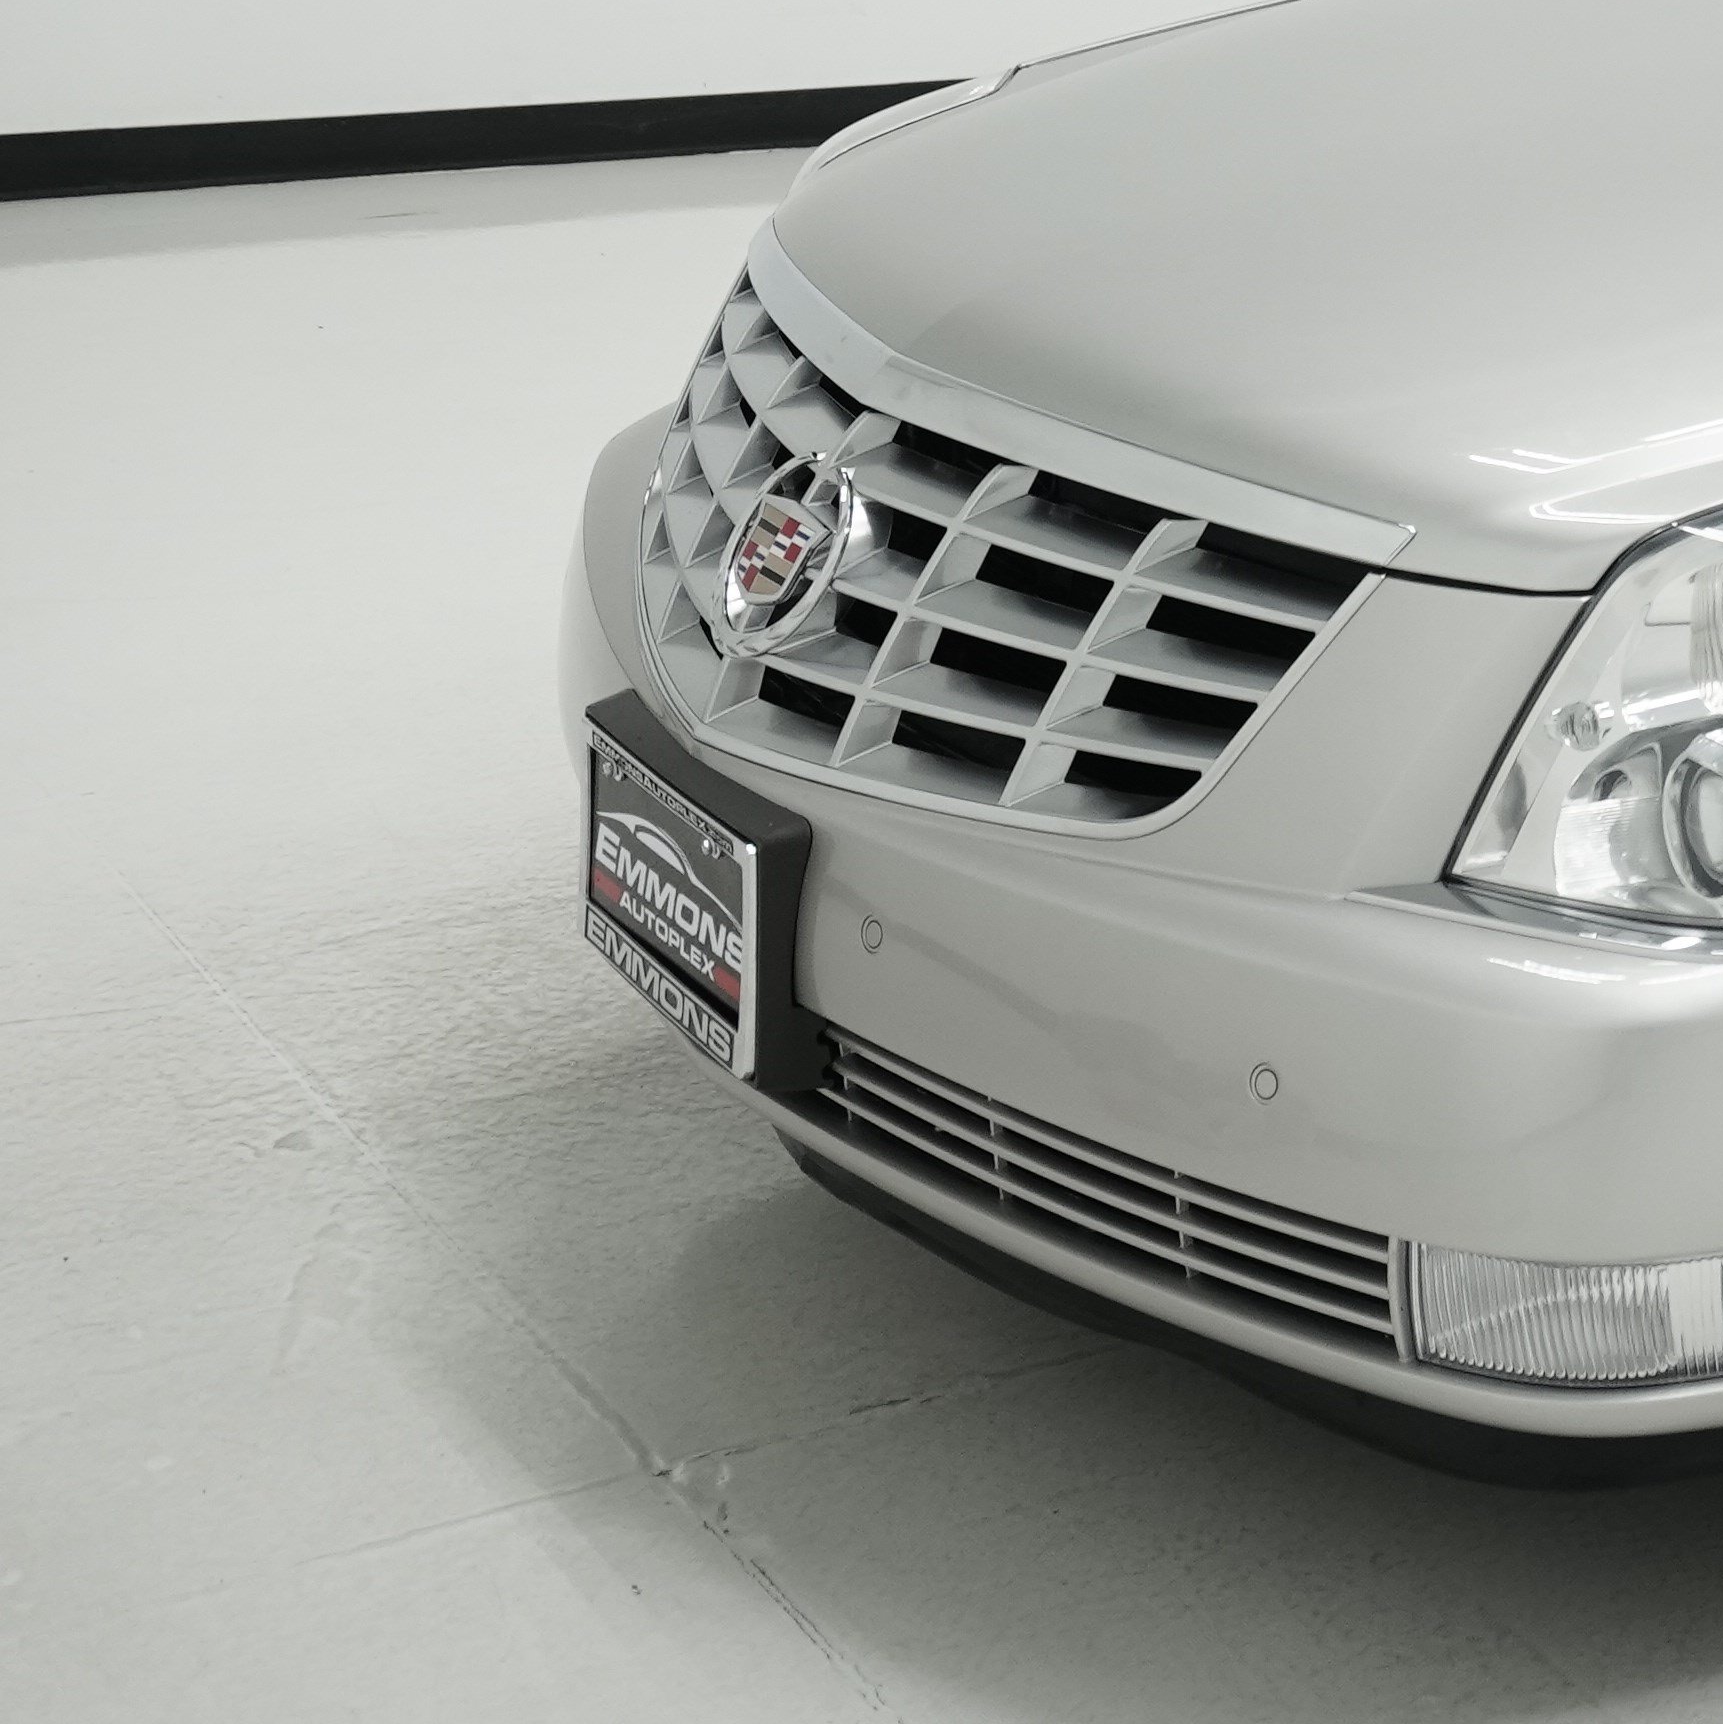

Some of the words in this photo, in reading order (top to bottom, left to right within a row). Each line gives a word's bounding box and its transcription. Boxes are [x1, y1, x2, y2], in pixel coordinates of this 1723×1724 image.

[595, 822, 742, 974] EMMONS
[619, 890, 716, 983] AUTOPLEX
[587, 910, 733, 1063] EMMONS
